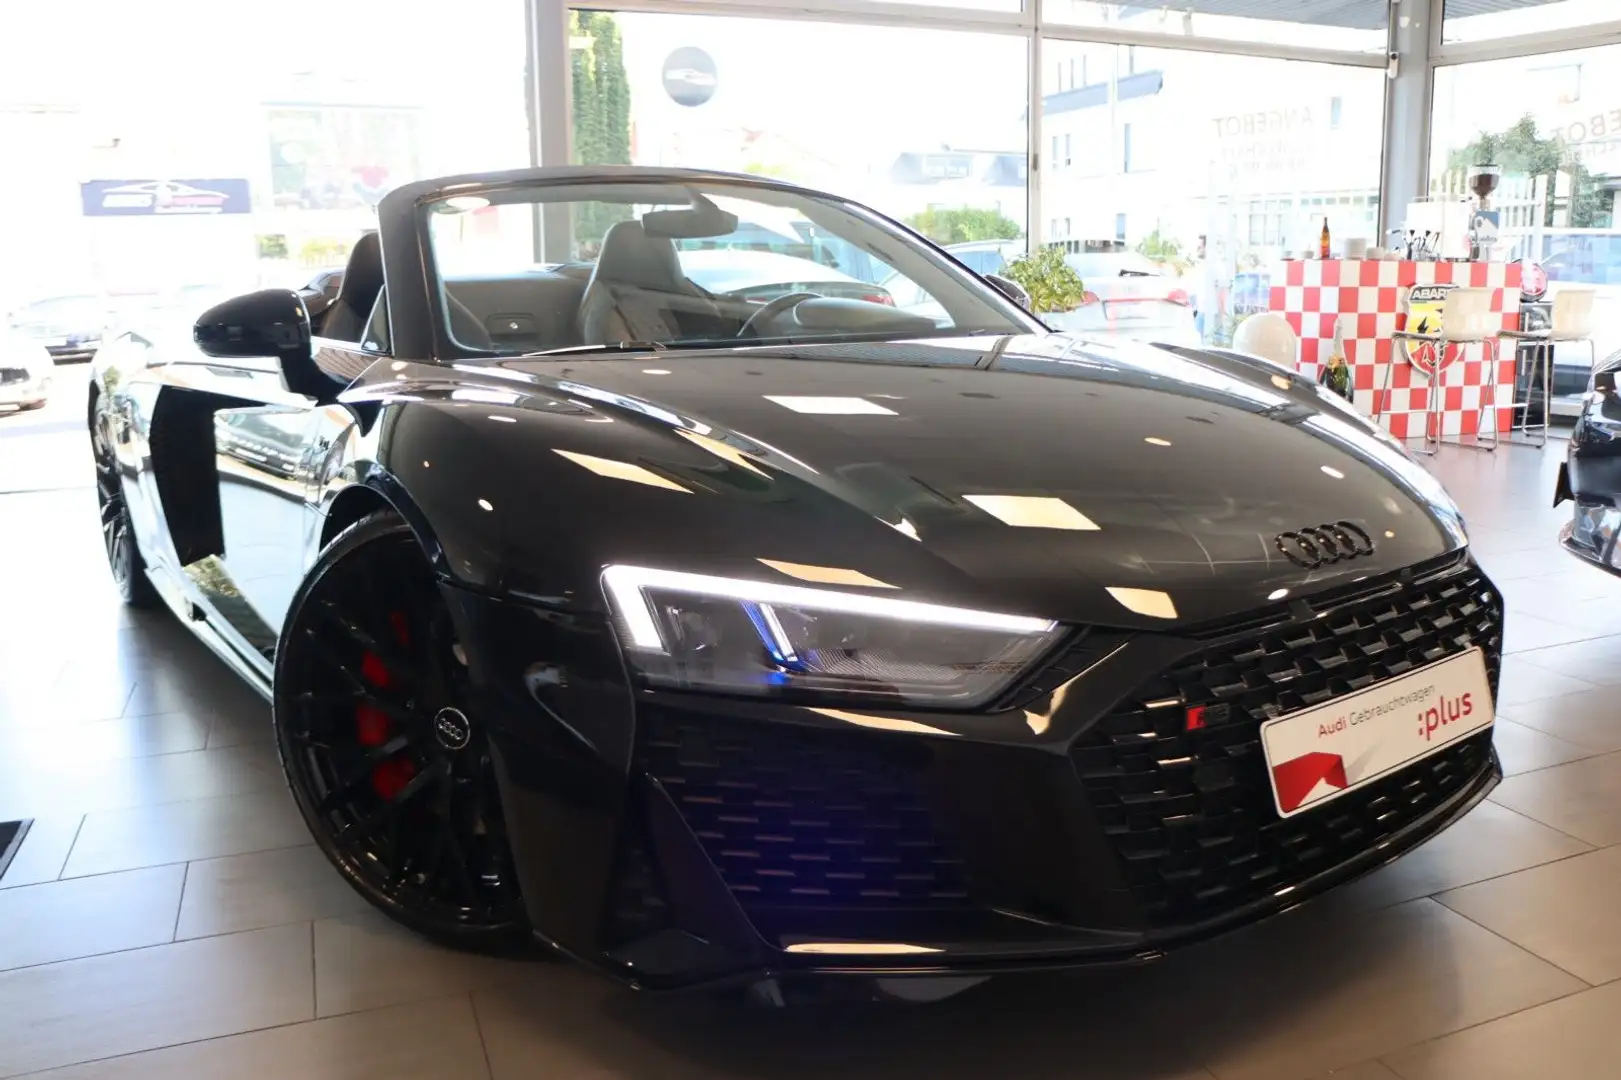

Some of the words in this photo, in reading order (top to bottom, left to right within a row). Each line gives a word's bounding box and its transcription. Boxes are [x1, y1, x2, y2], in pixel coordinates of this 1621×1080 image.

[1411, 287, 1447, 300] ABAR
[1318, 716, 1347, 738] Audi
[1348, 684, 1436, 726] Gebrauchtwagen
